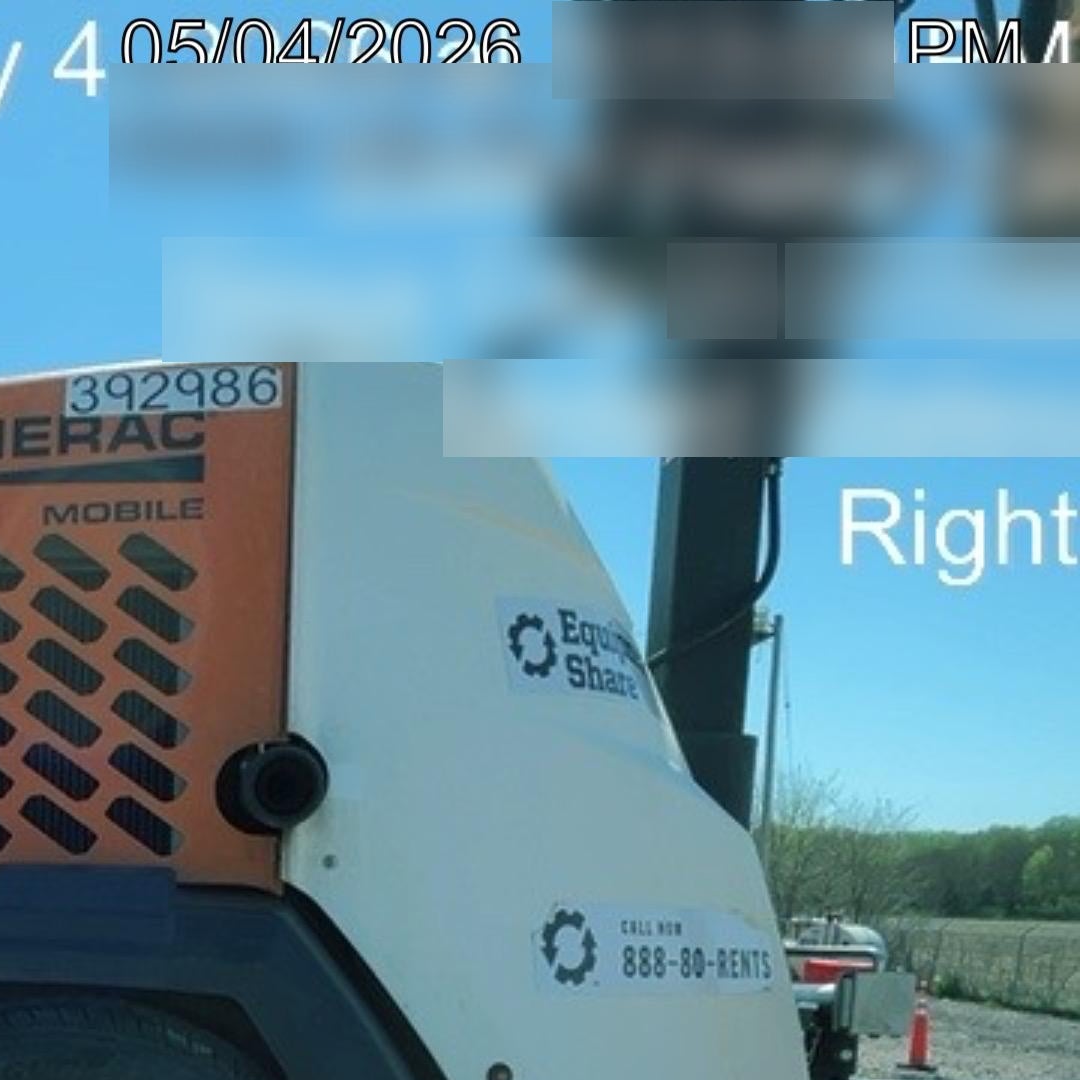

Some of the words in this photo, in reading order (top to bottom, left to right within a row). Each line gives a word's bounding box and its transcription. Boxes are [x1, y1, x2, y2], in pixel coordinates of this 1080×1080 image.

[69, 365, 279, 414] 392986
[42, 498, 205, 526] MOBILE
[566, 654, 640, 700] Share
[622, 944, 772, 980] 888-80-RENTS
